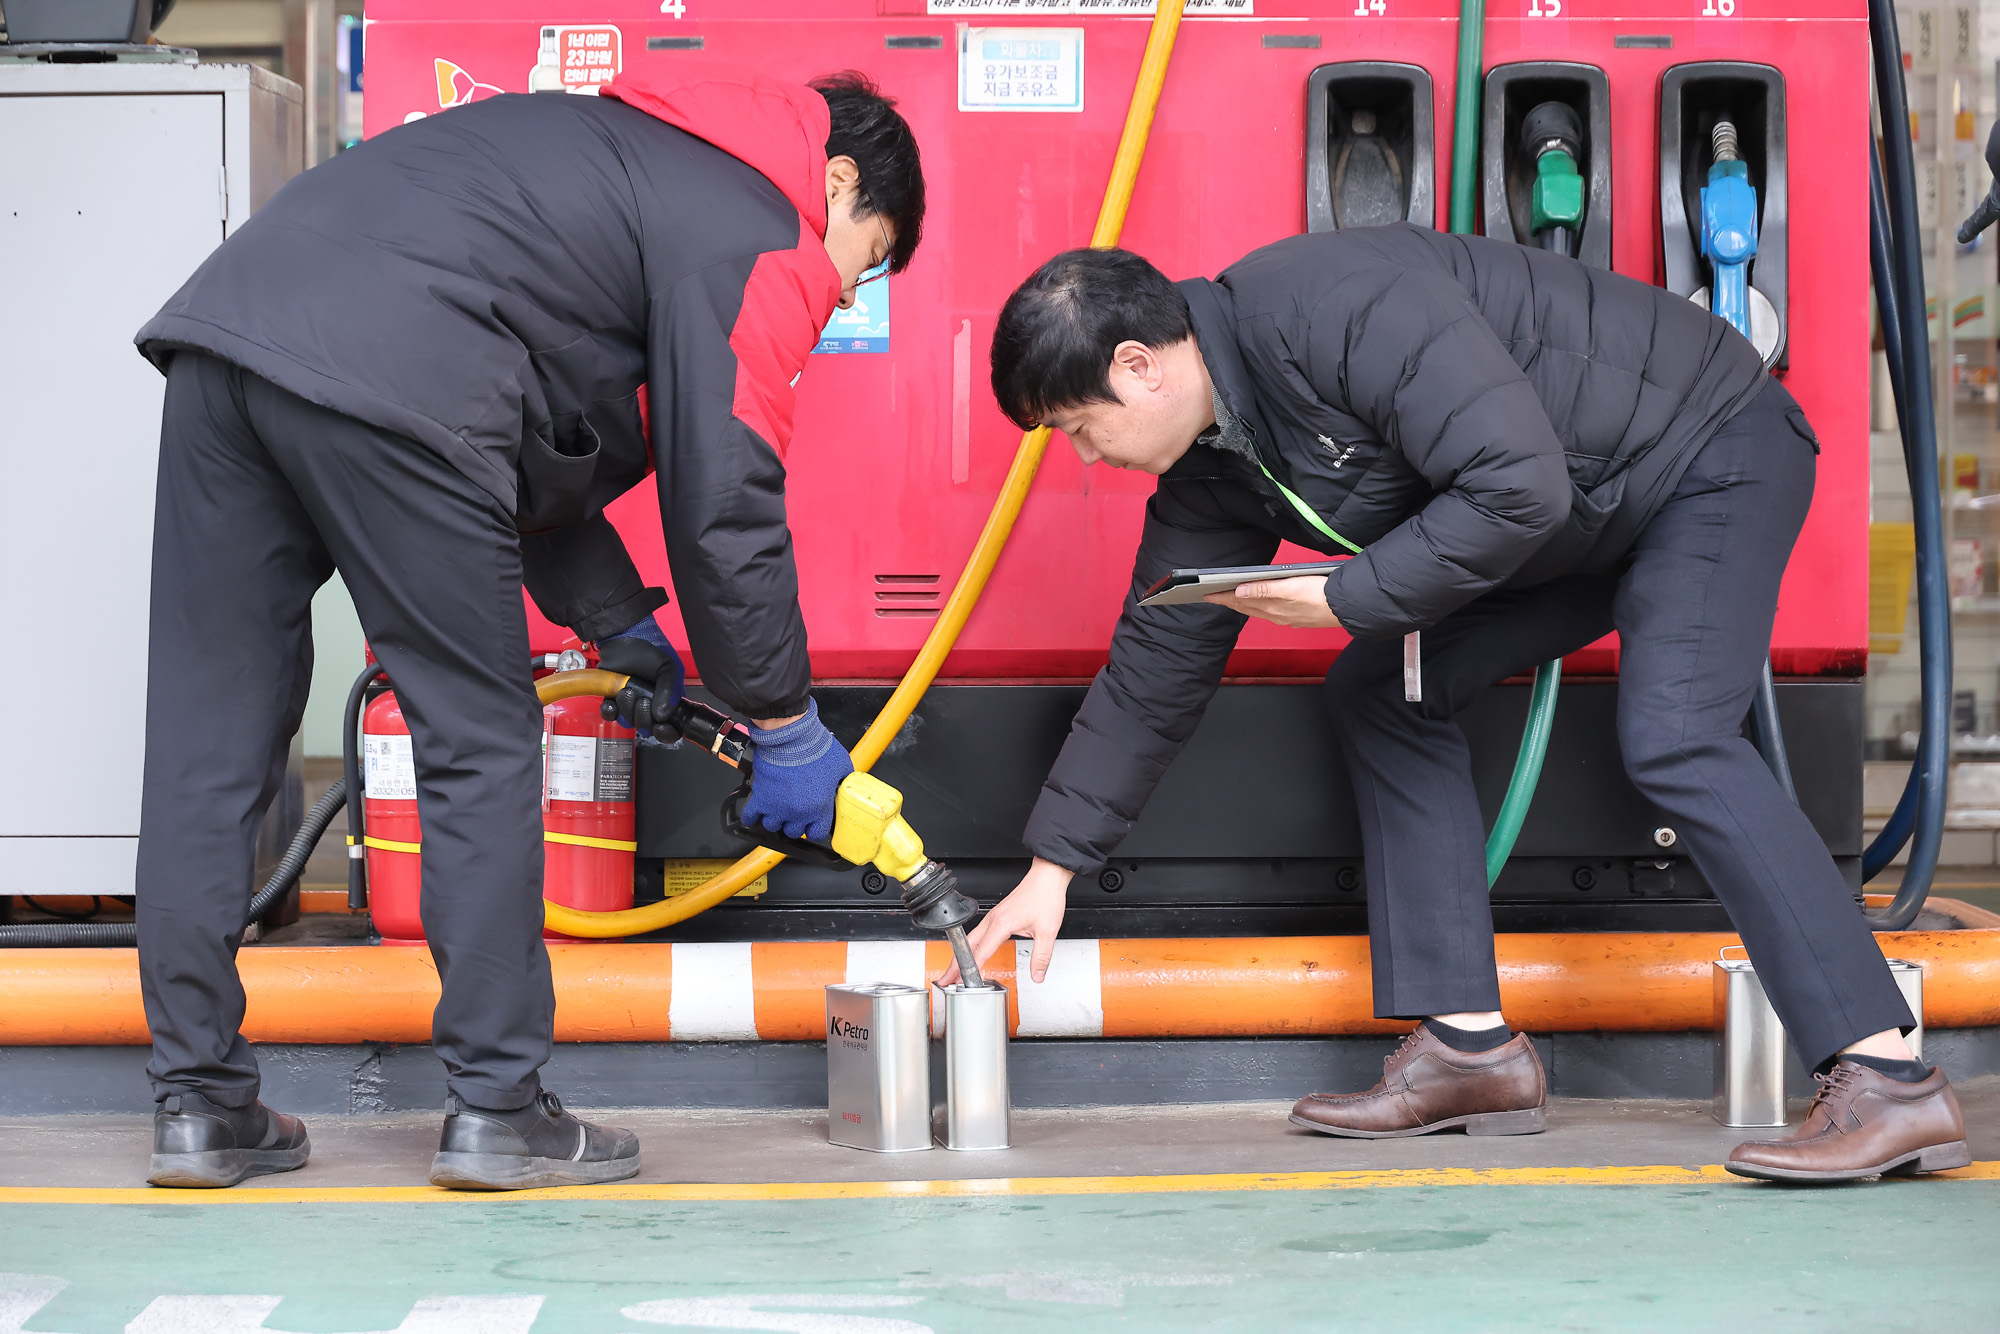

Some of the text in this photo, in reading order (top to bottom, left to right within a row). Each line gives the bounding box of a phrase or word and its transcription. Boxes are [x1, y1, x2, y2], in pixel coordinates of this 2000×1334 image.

[660, 0, 686, 19] 4
[1354, 0, 1387, 16] 14
[1528, 0, 1561, 17] 15
[1702, 0, 1735, 17] 16
[565, 49, 613, 67] 23만원
[564, 68, 615, 83] 연비 절약
[984, 64, 1059, 80] 유가보조금
[984, 82, 1058, 97] 지급 주유소
